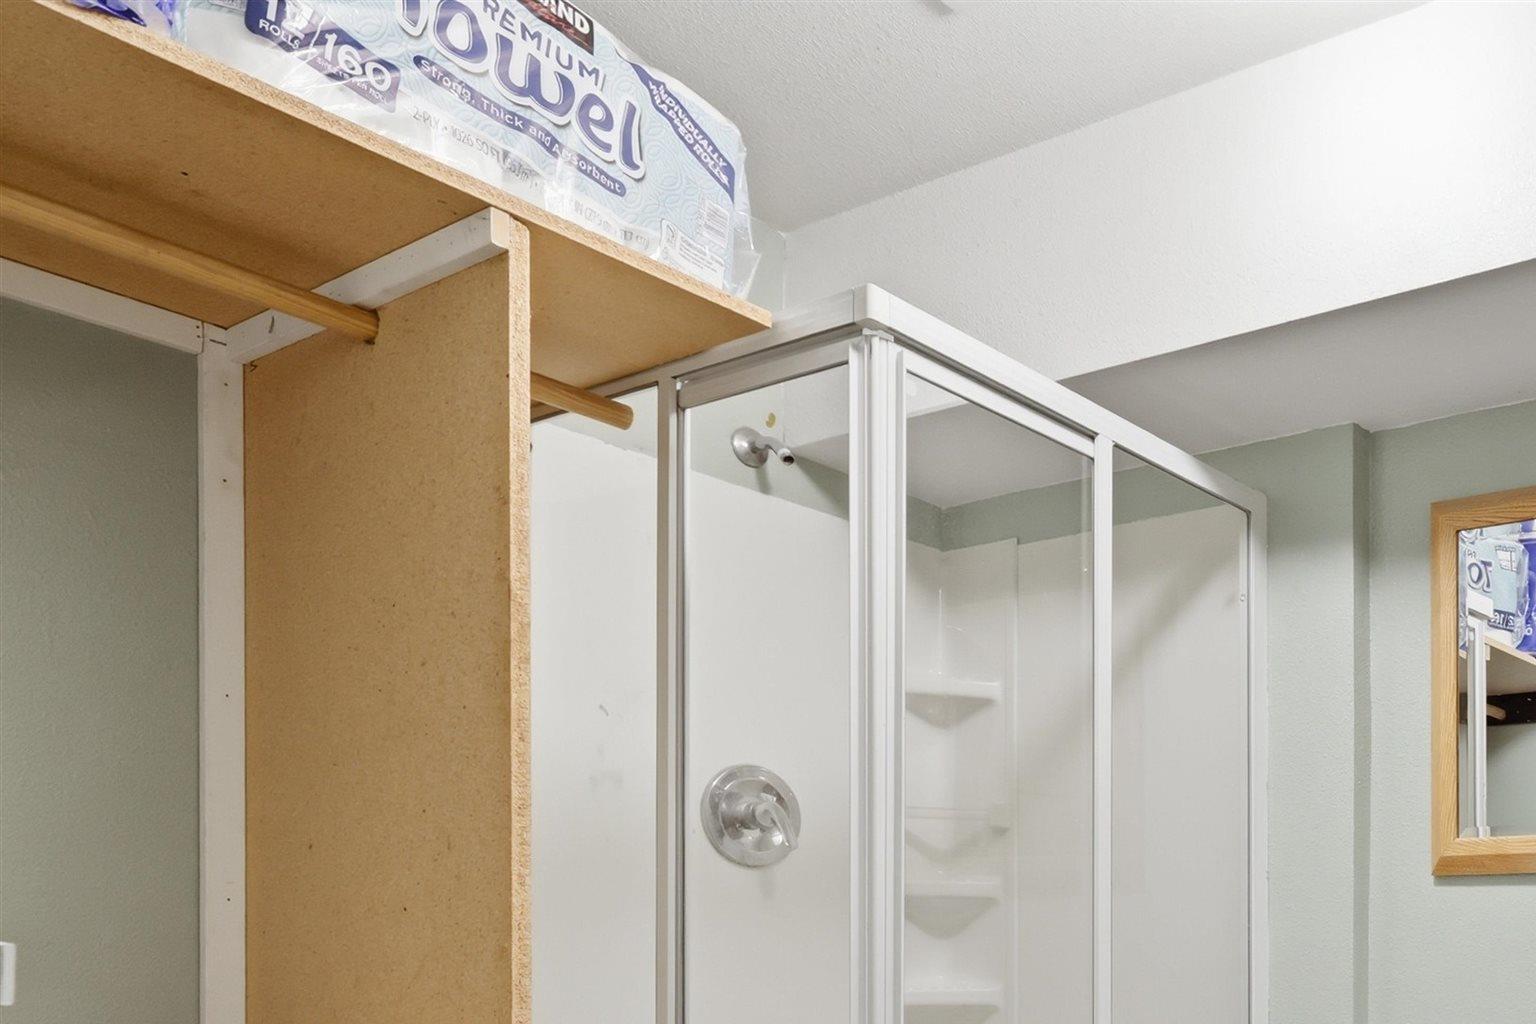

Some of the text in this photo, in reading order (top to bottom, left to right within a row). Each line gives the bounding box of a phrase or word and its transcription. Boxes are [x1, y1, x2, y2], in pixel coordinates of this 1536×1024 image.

[258, 18, 301, 49] ROLLS
[324, 33, 392, 92] 160
[483, 0, 602, 87] REMIUM
[481, 99, 525, 129] Thick
[528, 125, 552, 149] and
[648, 80, 695, 144] WRAPPED
[658, 84, 727, 167] INDIVIDUALLY
